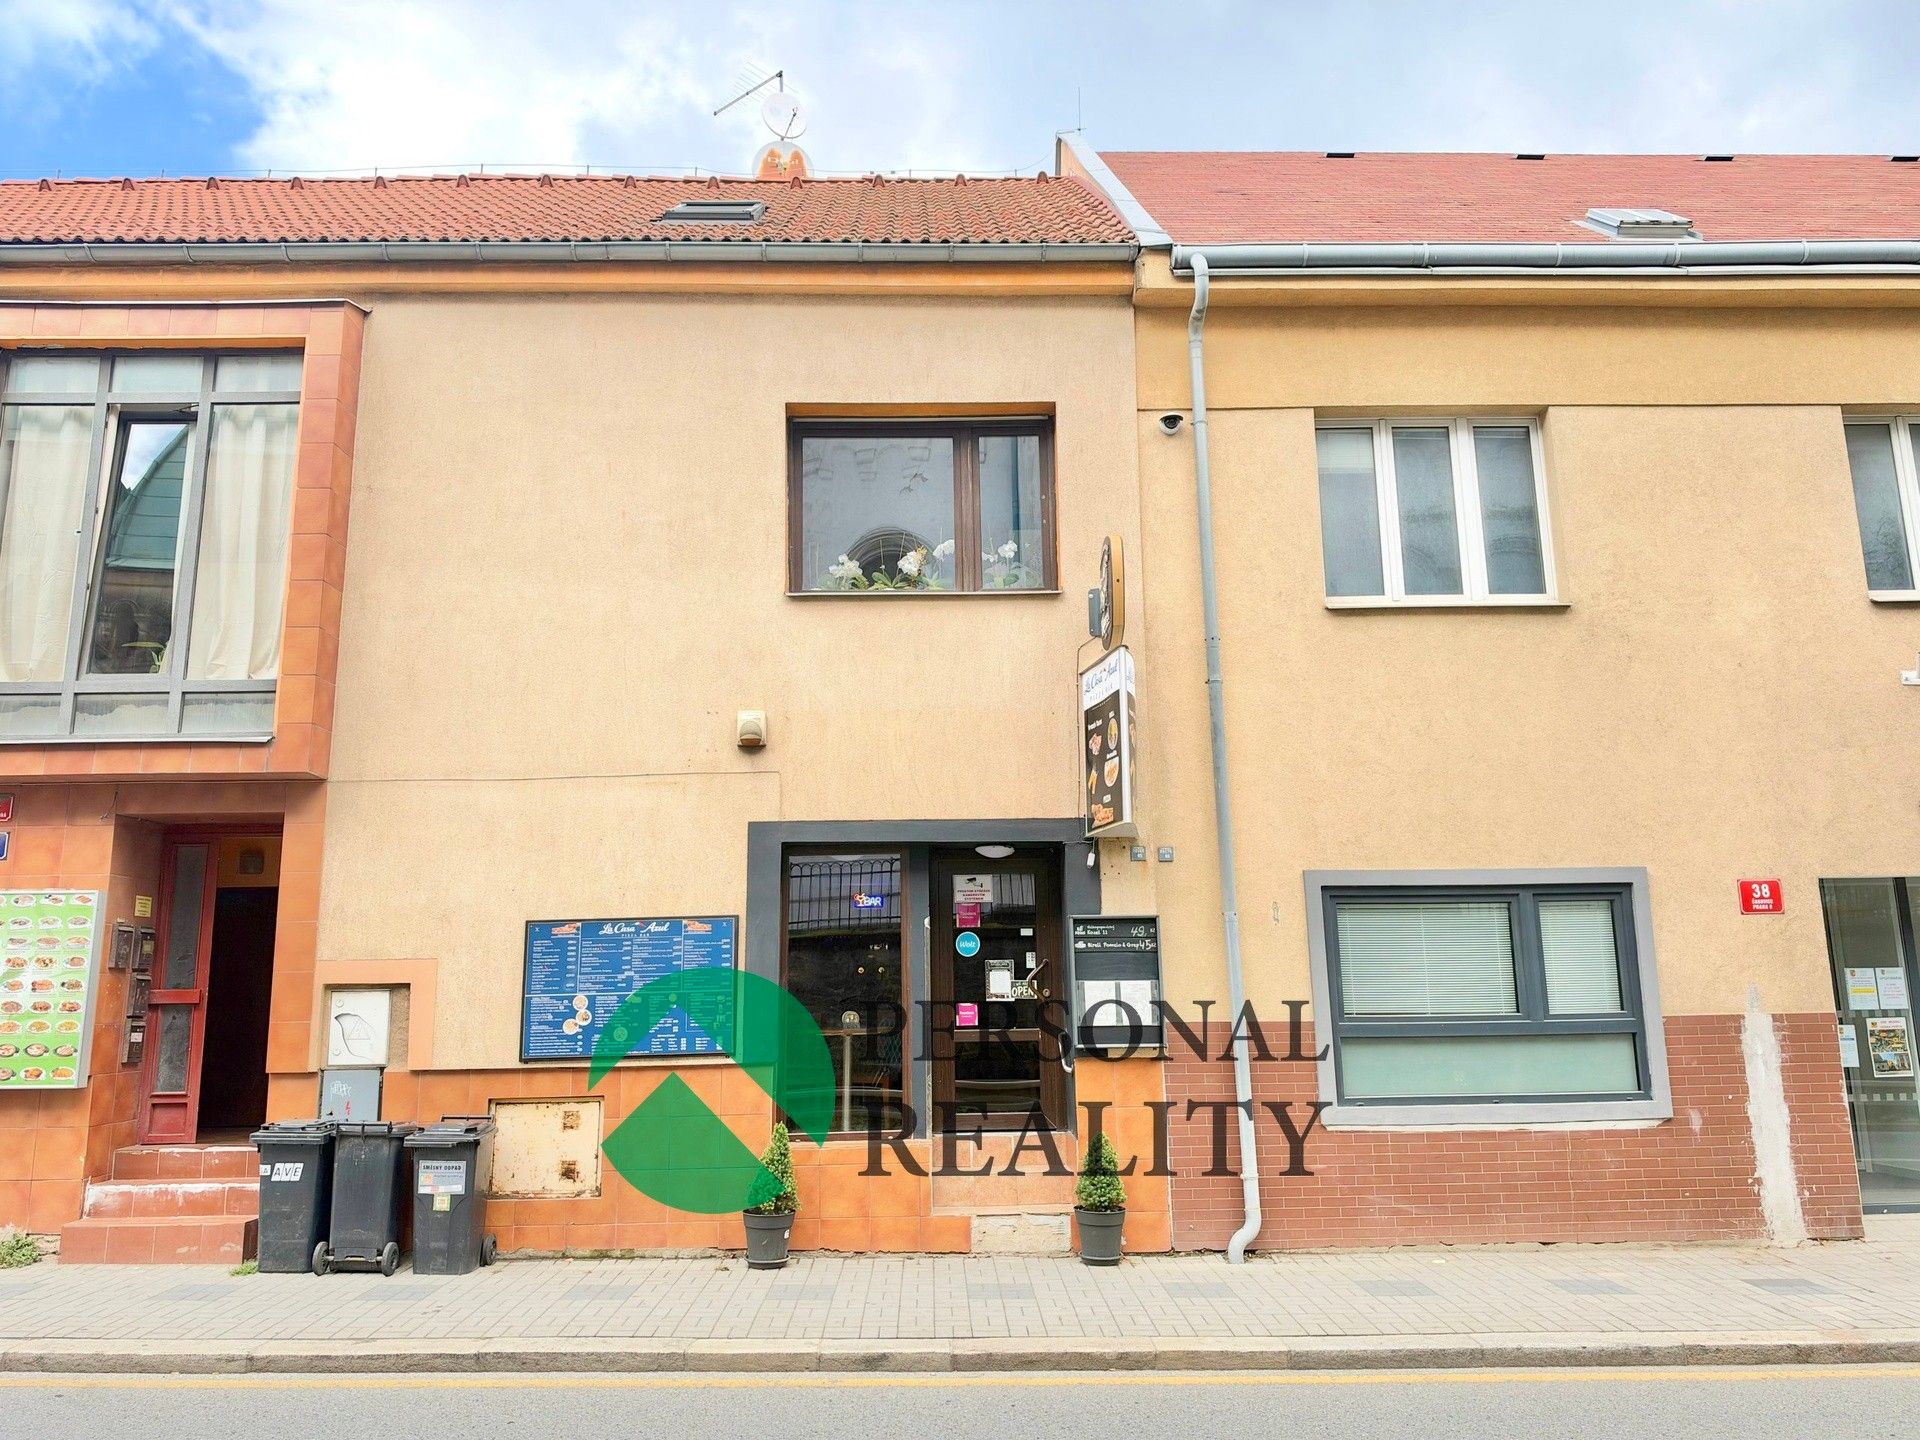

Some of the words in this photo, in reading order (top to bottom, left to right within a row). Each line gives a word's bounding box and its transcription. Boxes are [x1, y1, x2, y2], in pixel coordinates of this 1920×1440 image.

[1751, 884, 1770, 898] 38
[864, 896, 882, 906] BAR
[599, 923, 614, 935] La
[614, 922, 636, 933] Casa
[640, 921, 671, 933] Azul
[1011, 986, 1036, 998] OPEN
